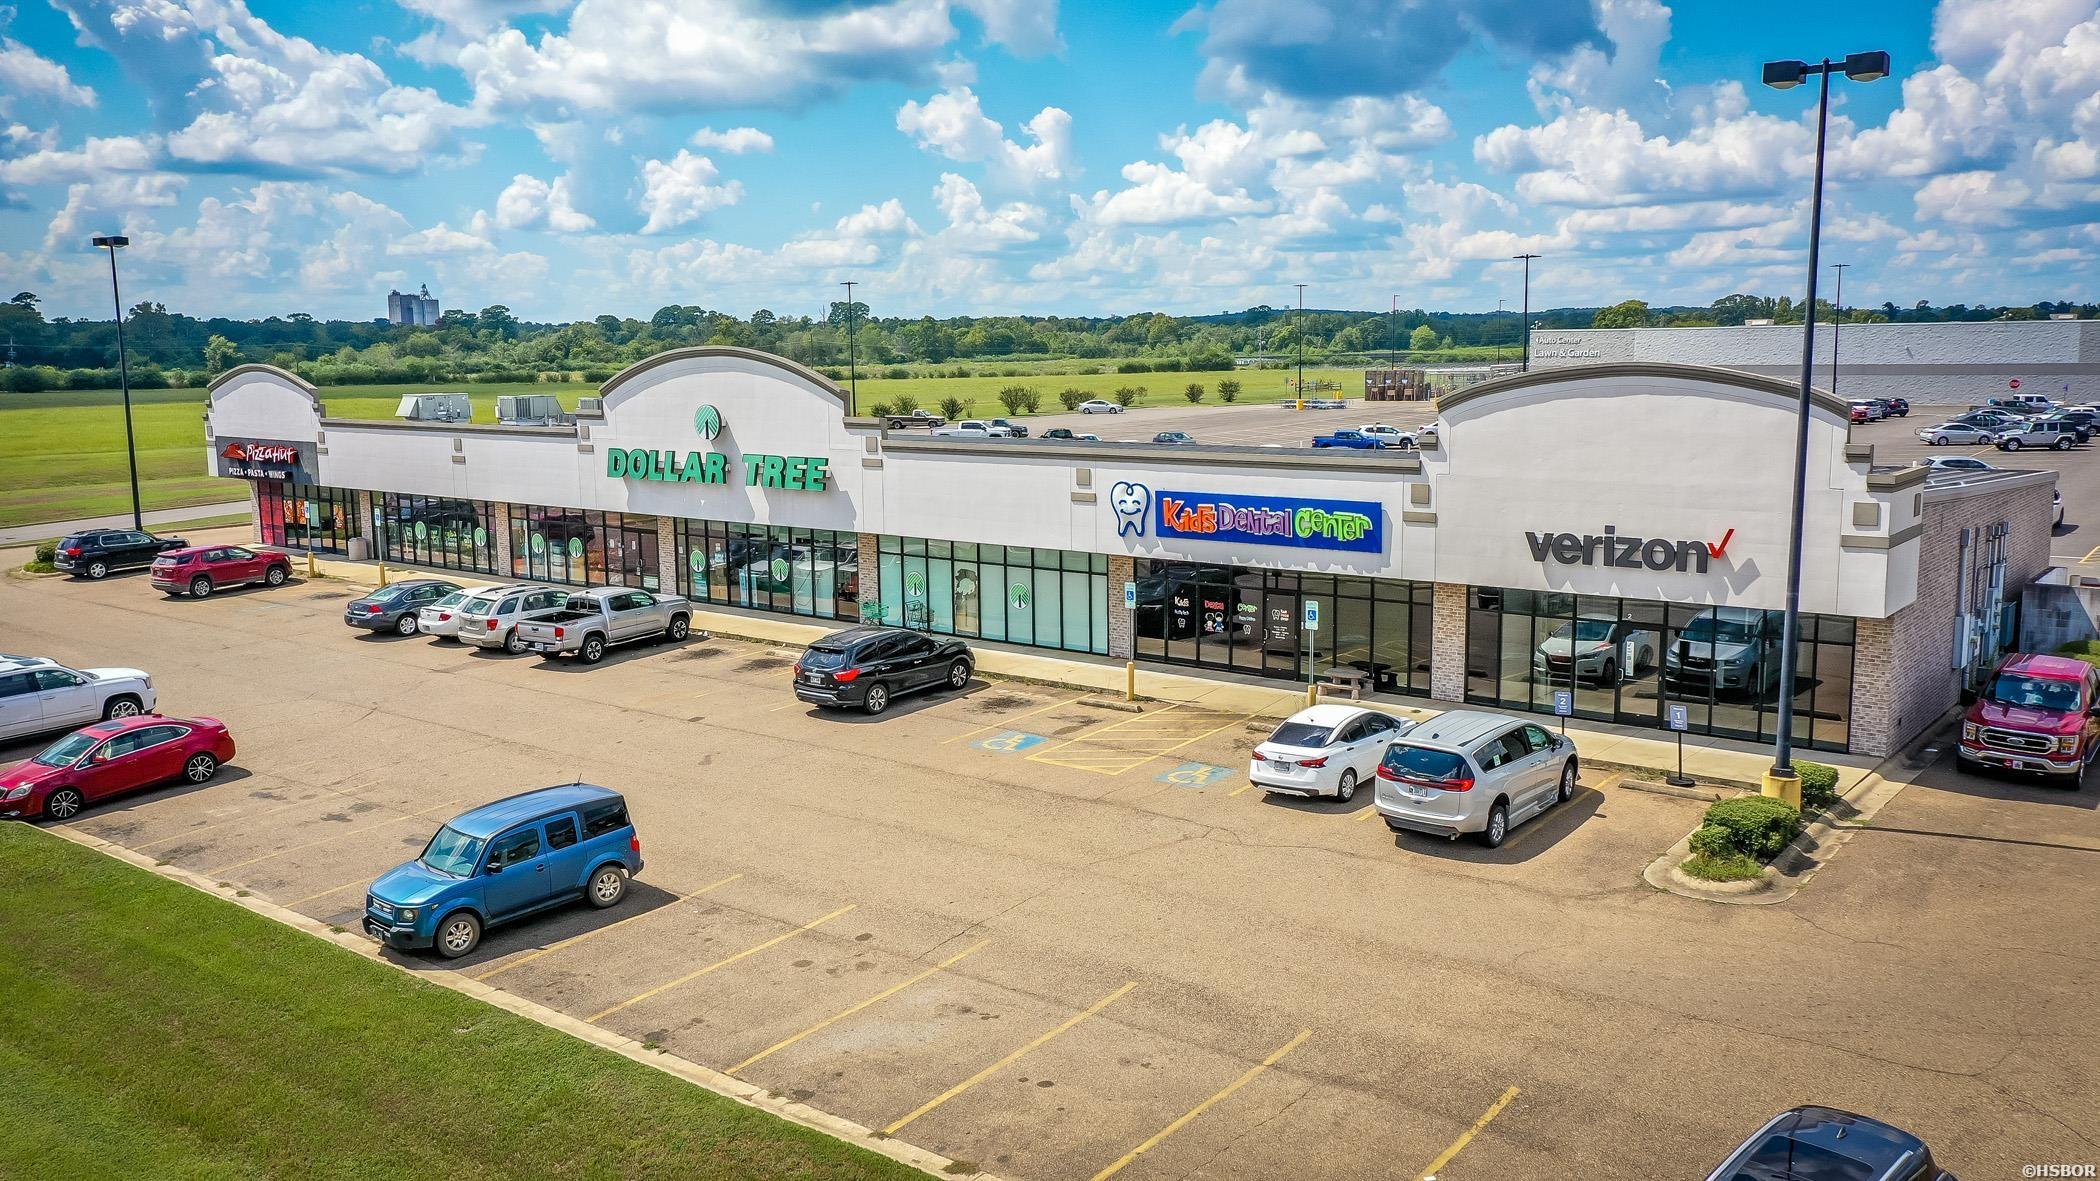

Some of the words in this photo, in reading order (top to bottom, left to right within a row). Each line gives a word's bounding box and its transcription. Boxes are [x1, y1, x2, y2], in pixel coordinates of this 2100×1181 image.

[1539, 336, 1556, 345] Auto
[1558, 336, 1582, 345] Center
[1534, 348, 1557, 358] Lawn
[1559, 348, 1566, 358] &
[1567, 347, 1601, 358] Garden
[228, 467, 244, 476] PIZZA
[247, 468, 265, 478] PASTA
[268, 470, 286, 479] WINGS
[607, 447, 730, 485] DOLLAR
[742, 453, 829, 492] TREE
[1525, 524, 1708, 574] verizon
[1560, 697, 1567, 705] 2
